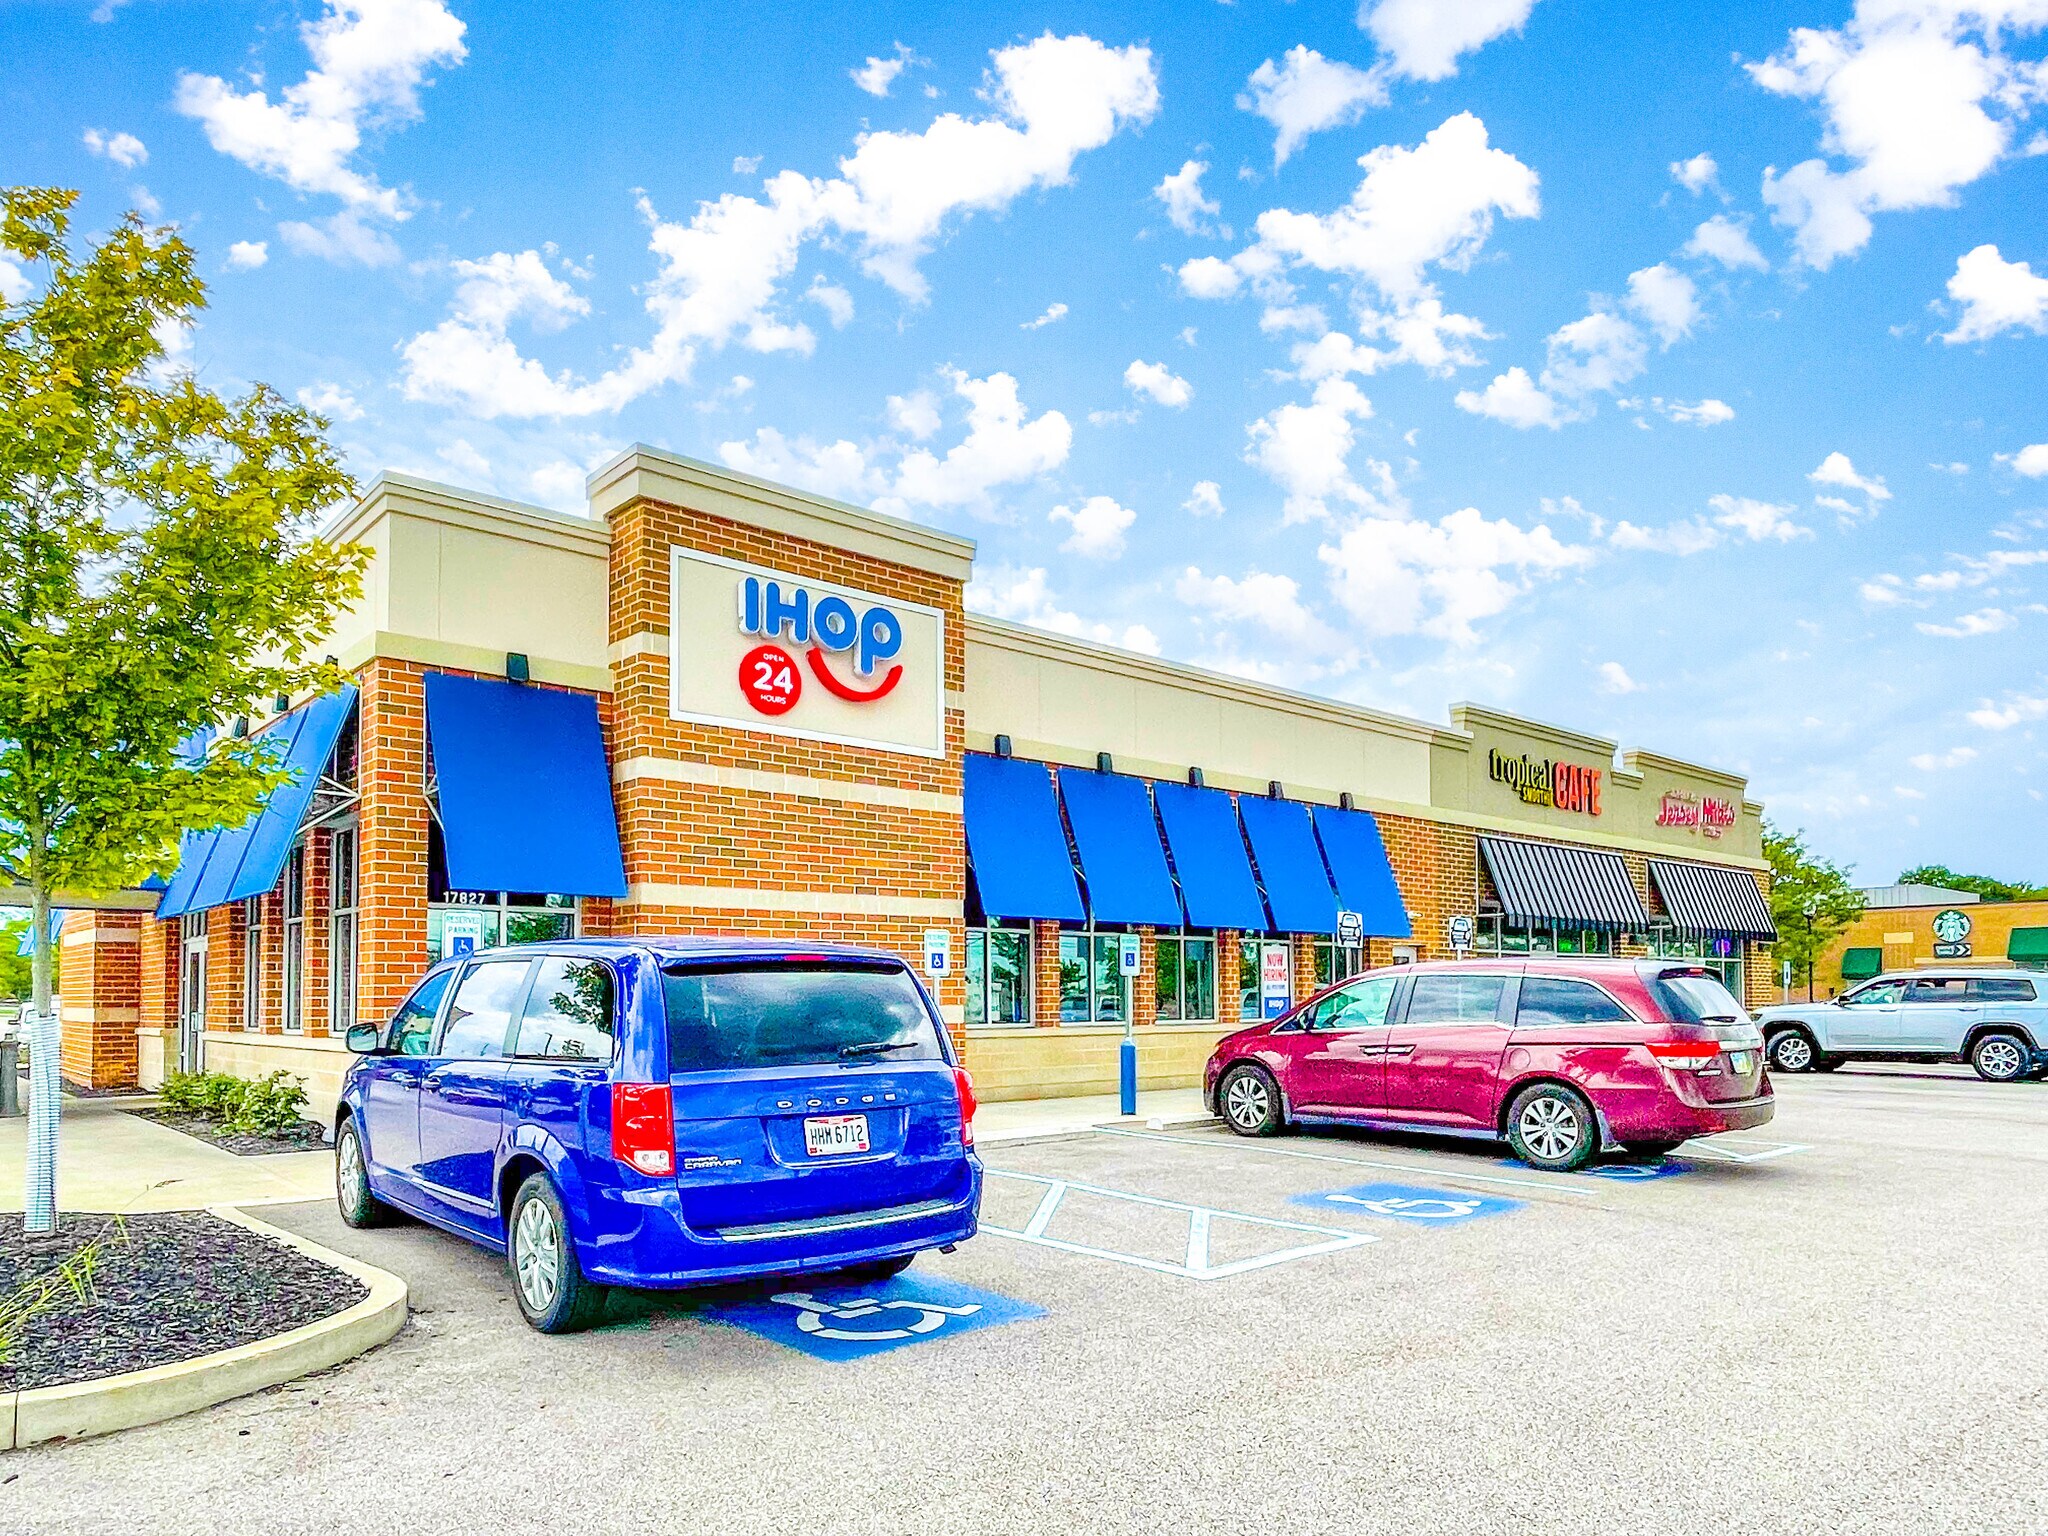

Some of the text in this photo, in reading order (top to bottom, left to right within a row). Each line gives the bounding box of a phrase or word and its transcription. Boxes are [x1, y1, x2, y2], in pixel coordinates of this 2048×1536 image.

[738, 577, 903, 677] IHOP
[763, 653, 784, 662] OPEN
[753, 661, 794, 695] 24
[760, 694, 787, 705] HOURS
[1489, 748, 1602, 816] tropical CAFE
[443, 891, 486, 905] 17827
[447, 926, 479, 935] PARKING
[1266, 953, 1284, 967] NOW
[1263, 968, 1288, 982] HIRING
[776, 1093, 897, 1109] DODGE
[810, 1124, 865, 1145] HHM 6712
[684, 1158, 742, 1170] CARAVAN
